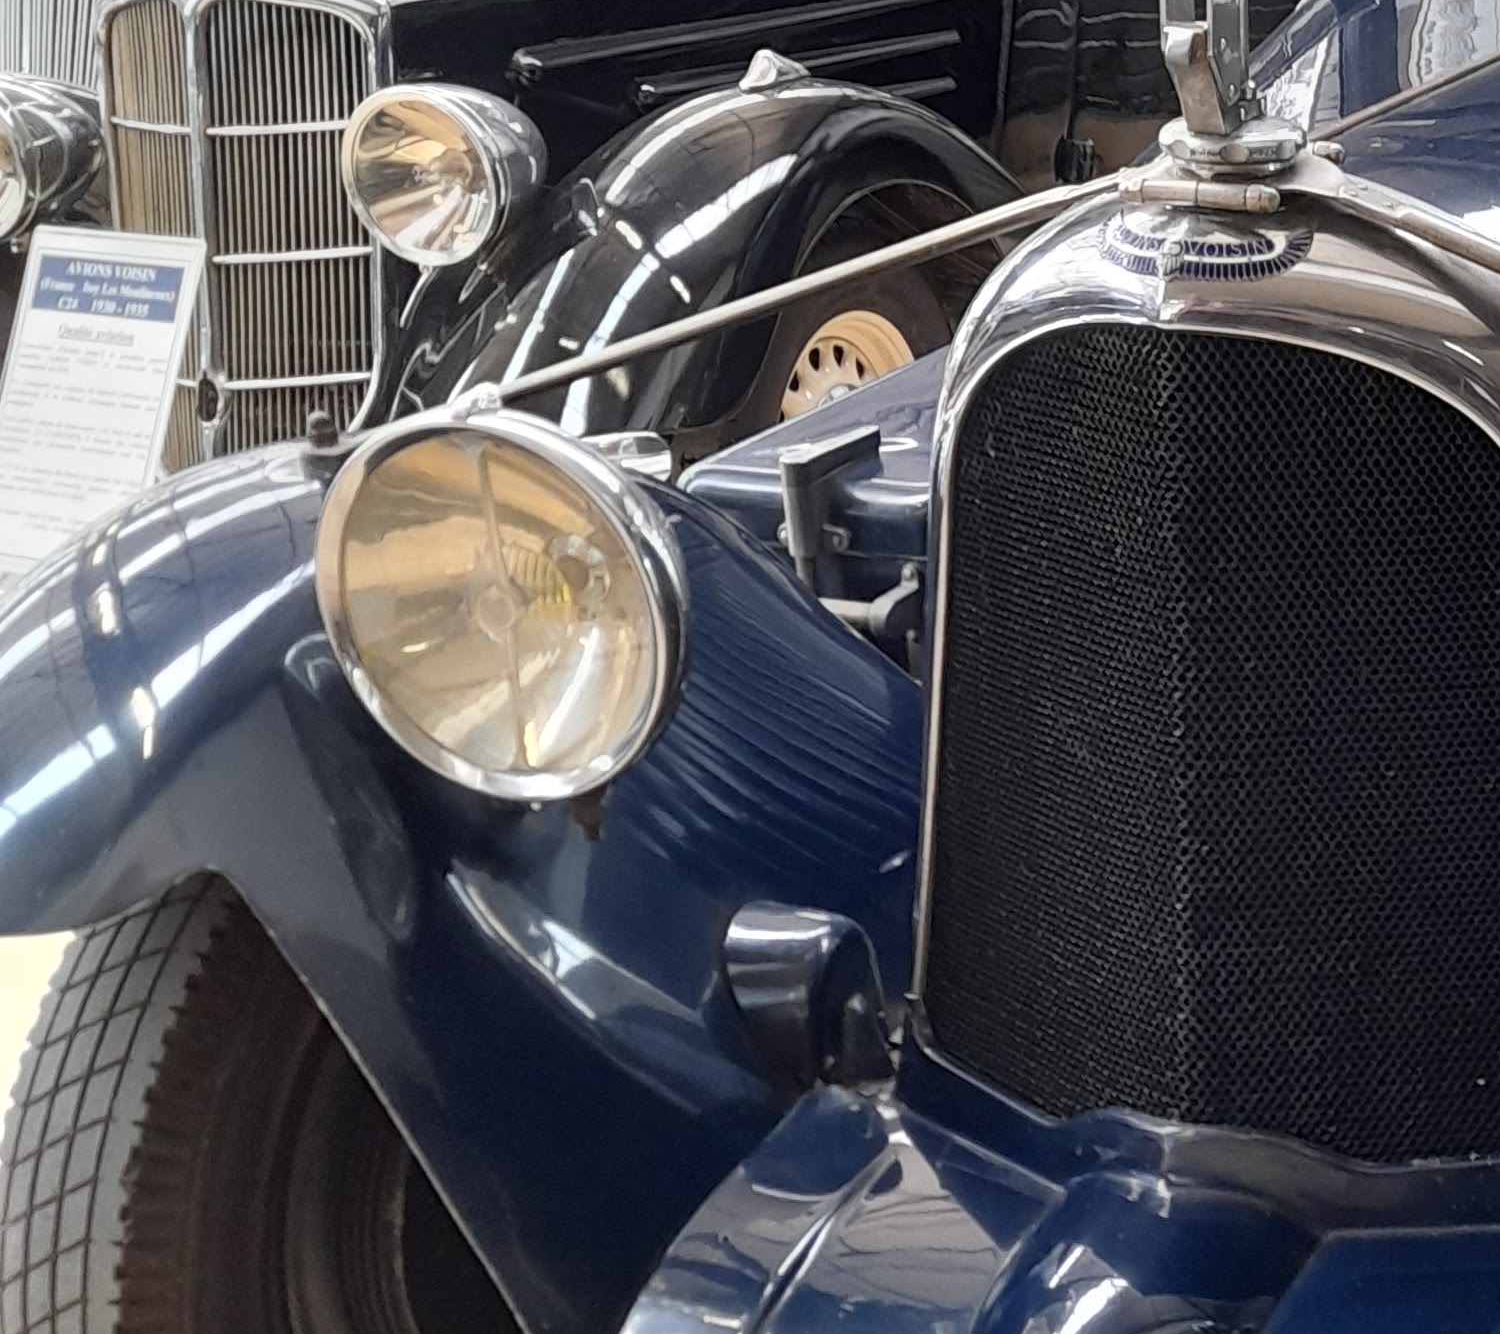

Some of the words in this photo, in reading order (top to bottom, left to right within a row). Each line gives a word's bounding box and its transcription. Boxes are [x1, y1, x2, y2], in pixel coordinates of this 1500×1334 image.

[1187, 240, 1268, 257] VOISIN
[65, 260, 113, 278] AVIONS
[114, 264, 158, 282] VOISIN
